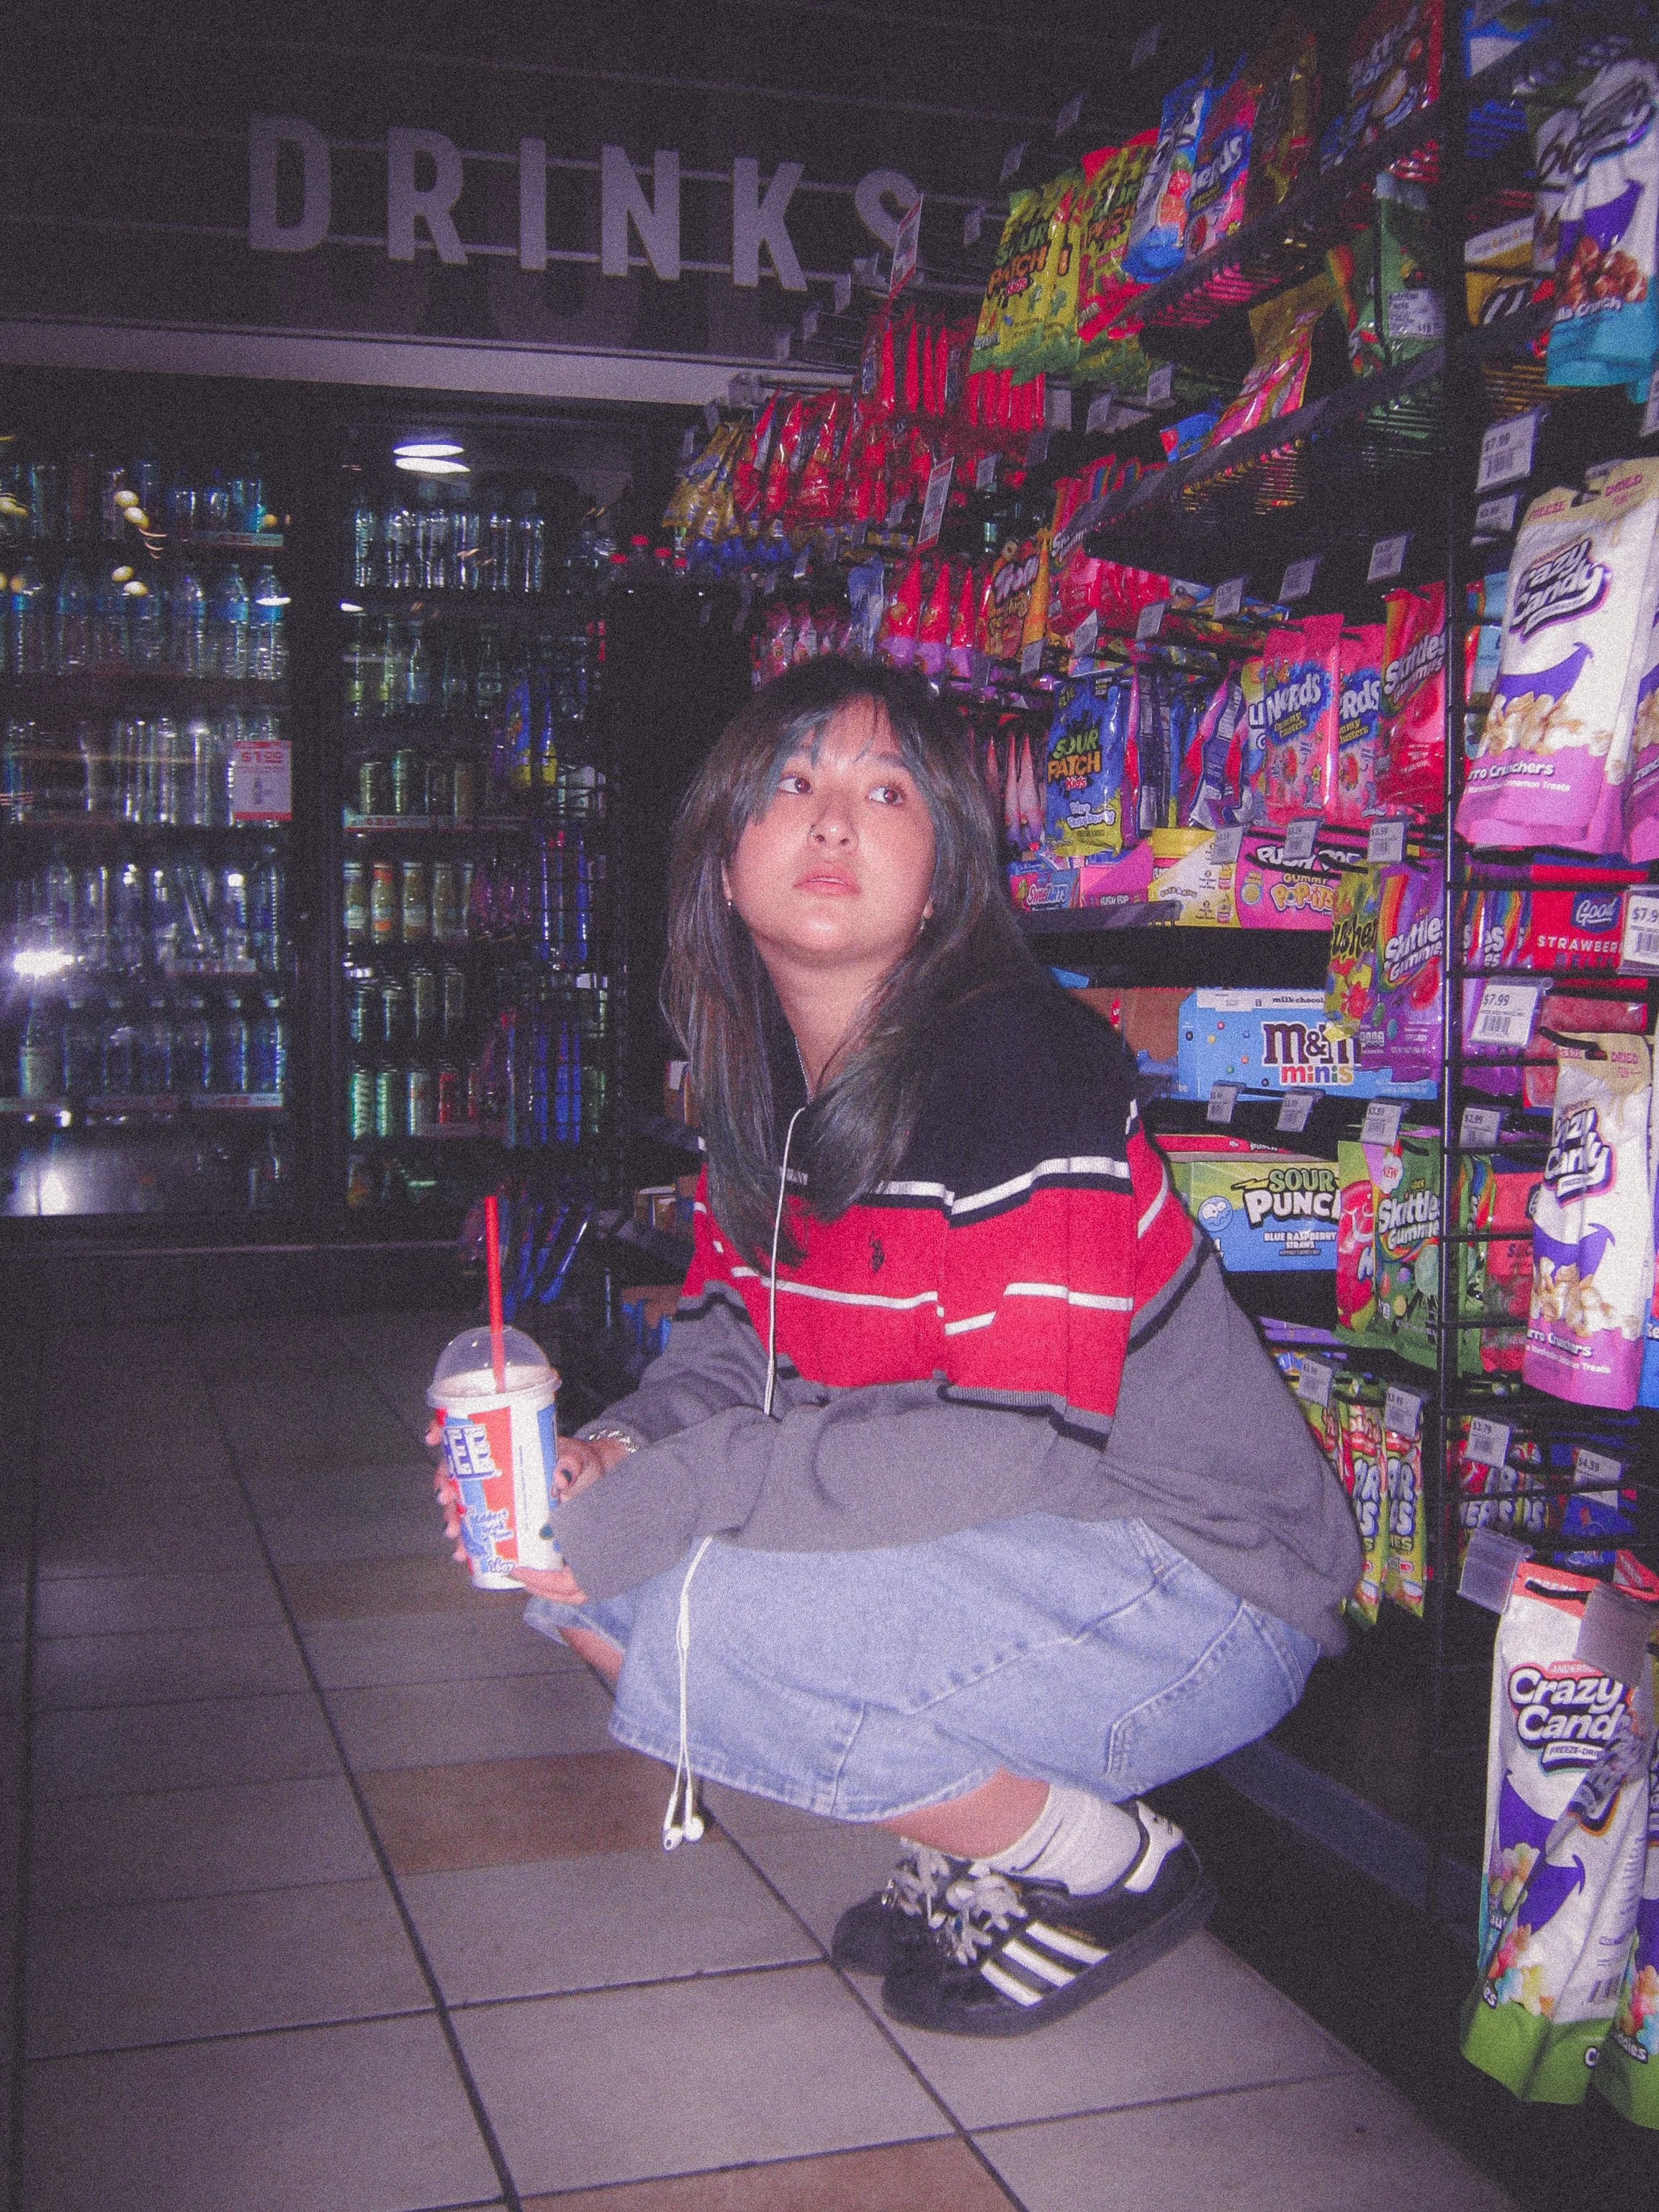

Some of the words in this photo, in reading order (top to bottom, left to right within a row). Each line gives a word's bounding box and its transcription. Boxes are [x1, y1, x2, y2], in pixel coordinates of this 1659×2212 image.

[248, 114, 927, 291] DRINKS
[1511, 563, 1606, 626] Candy
[1340, 679, 1380, 720] Rds
[1339, 717, 1361, 733] mmy
[1339, 725, 1369, 743] lusters
[1051, 728, 1100, 759] SOUR
[1047, 750, 1101, 783] PATCH
[1467, 768, 1487, 781] rro
[1575, 897, 1617, 927] Good
[1537, 935, 1621, 953] STRAWBER
[1390, 940, 1443, 983] Gummie
[1295, 996, 1324, 1004] chocol
[1483, 993, 1509, 1007] $7.99
[1262, 1022, 1362, 1066] m&m
[1281, 1065, 1354, 1084] minis
[1544, 1132, 1611, 1181] Cany
[1269, 1168, 1335, 1192] SOUR
[1382, 1167, 1398, 1179] NEW
[1378, 1189, 1440, 1235] Skittle
[1264, 1232, 1285, 1241] BLUE
[1286, 1231, 1337, 1241] RASPBERRY
[1387, 1220, 1440, 1251] Gummie
[1509, 1666, 1624, 1715] Crazy
[1516, 1702, 1627, 1741] Cand
